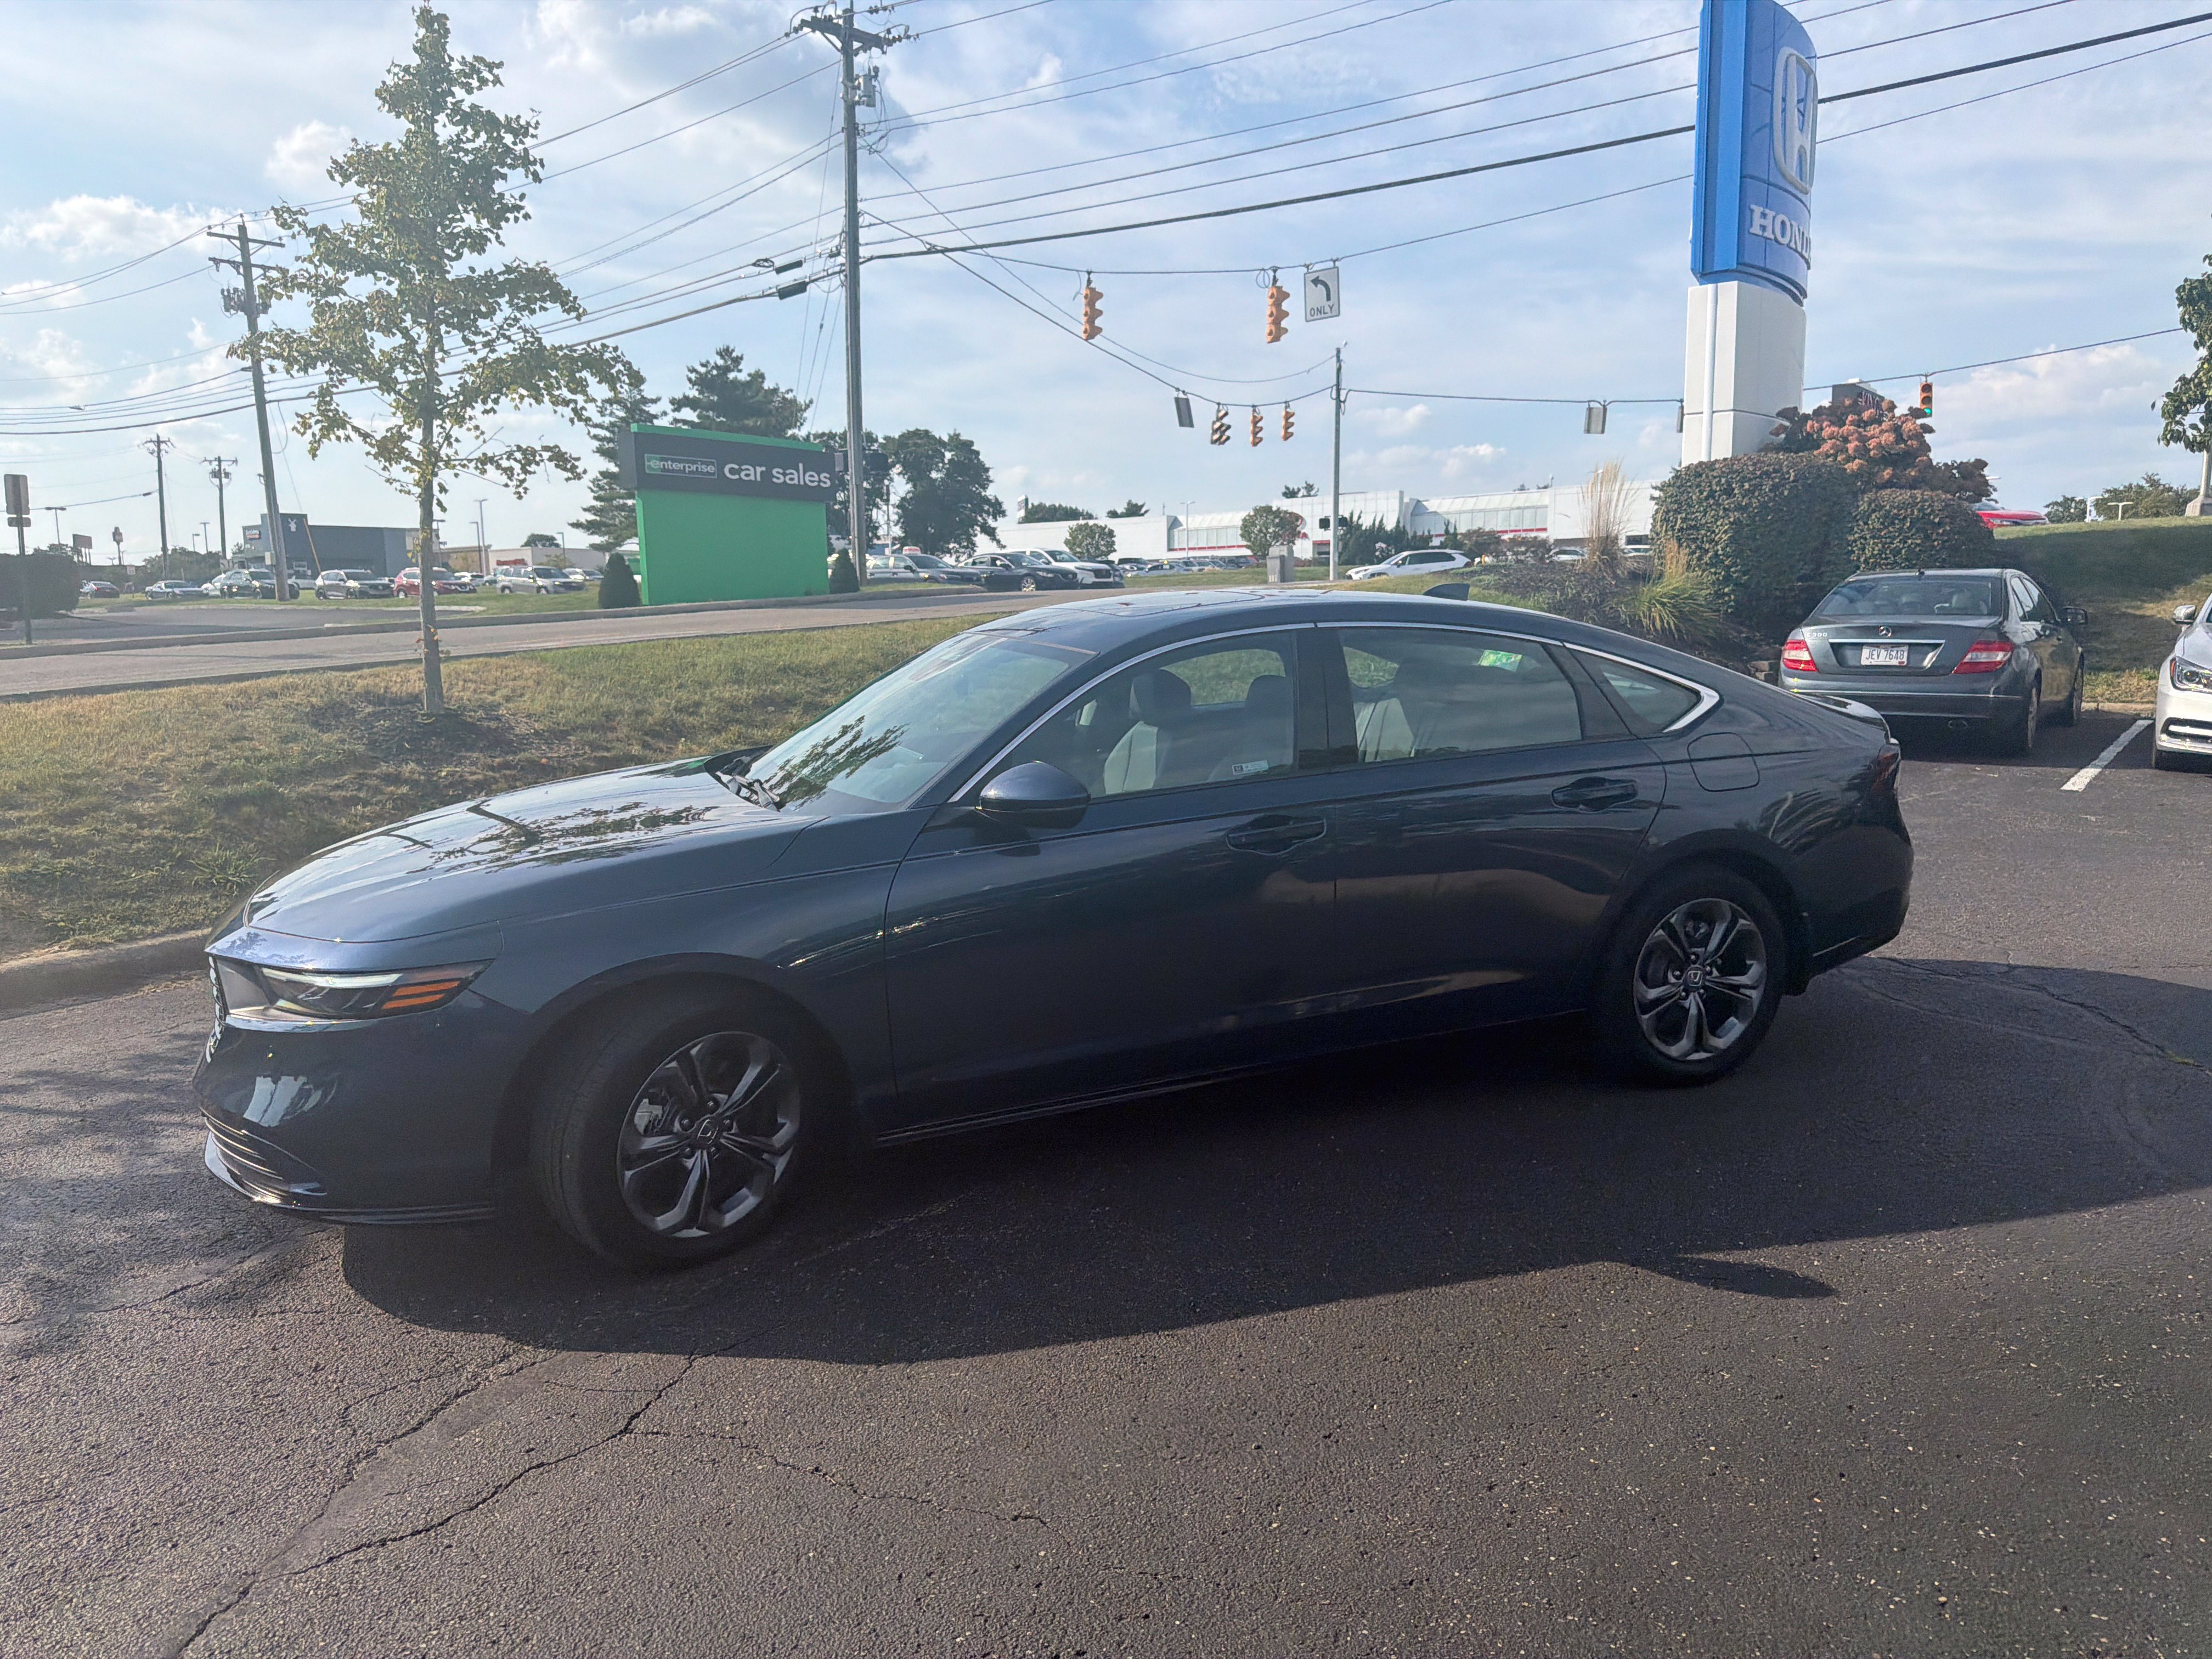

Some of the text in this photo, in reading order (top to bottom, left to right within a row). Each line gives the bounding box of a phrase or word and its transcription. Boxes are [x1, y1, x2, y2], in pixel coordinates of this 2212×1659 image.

[1750, 204, 1810, 264] HOND
[1310, 303, 1334, 317] ONLY
[650, 459, 831, 488] enterprise car sales
[1865, 649, 1905, 661] JEV 7648
